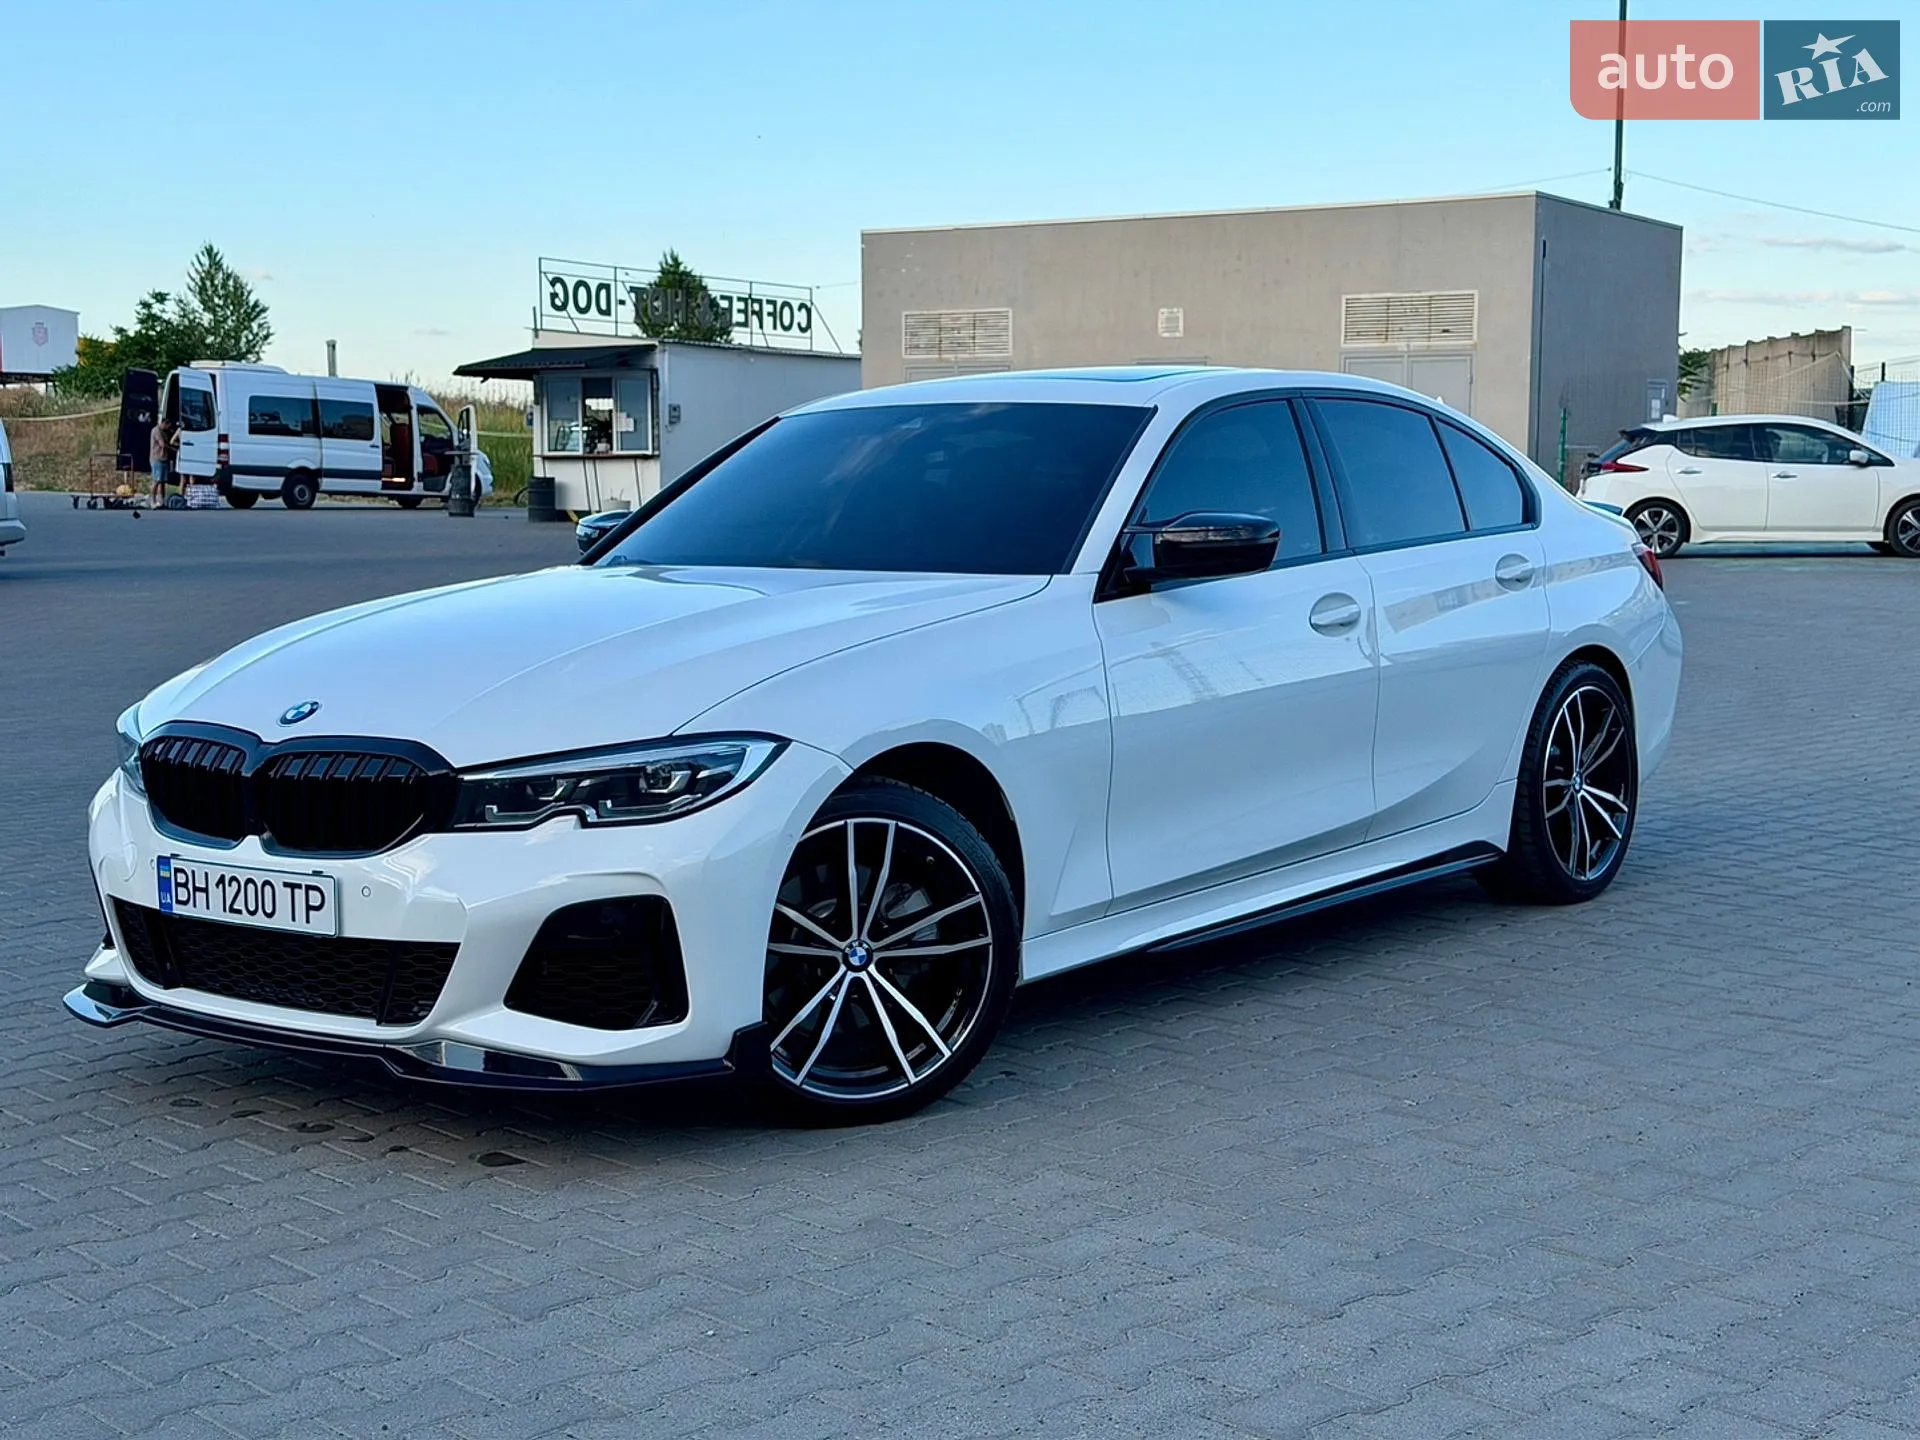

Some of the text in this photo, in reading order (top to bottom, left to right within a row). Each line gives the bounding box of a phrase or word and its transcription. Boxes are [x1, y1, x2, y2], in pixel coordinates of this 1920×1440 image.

[161, 891, 172, 904] UA
[173, 867, 326, 924] BH 1200 TP
